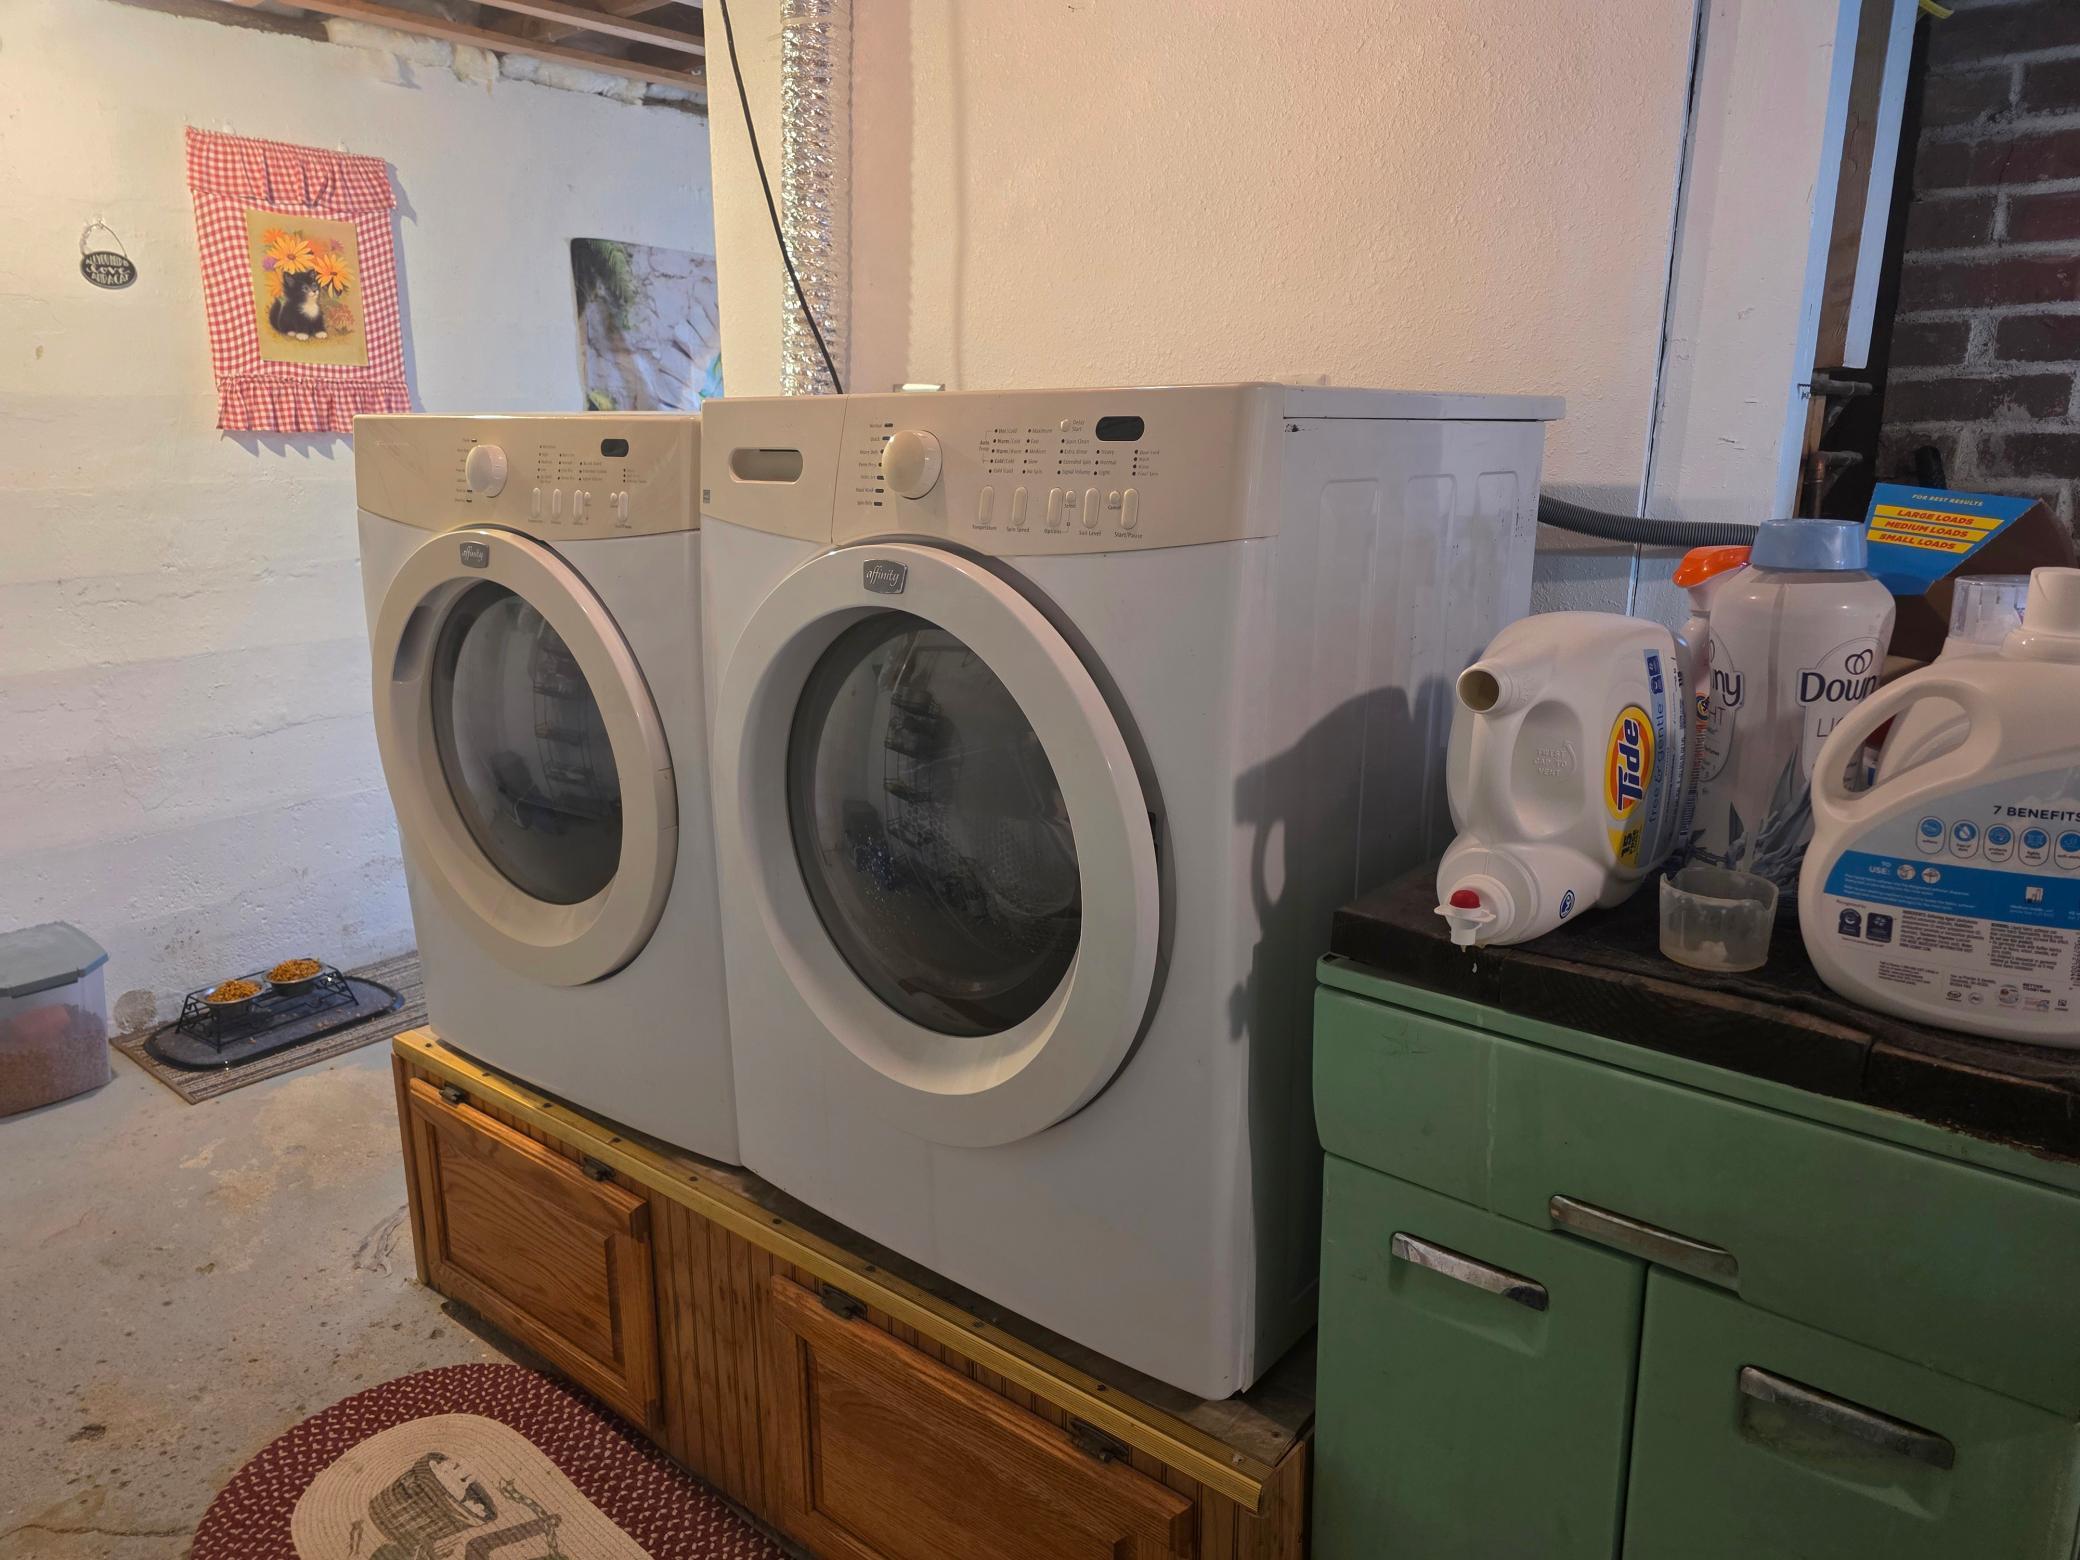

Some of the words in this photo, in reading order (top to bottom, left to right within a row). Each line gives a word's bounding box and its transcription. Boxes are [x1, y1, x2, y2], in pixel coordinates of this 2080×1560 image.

[1948, 498, 1985, 507] RESULTS
[1897, 509, 1936, 520] LARGE
[1936, 514, 1975, 526] LOADS
[1884, 520, 1929, 533] MEDIUM
[1928, 527, 1969, 538] LOADS
[1879, 533, 1915, 545] SMALL
[1916, 539, 1957, 550] LOADS
[866, 565, 900, 587] affinity
[1800, 672, 1877, 702] Down
[1657, 703, 1666, 764] gentle
[1617, 718, 1644, 811] Tide
[1993, 805, 2002, 815] 7
